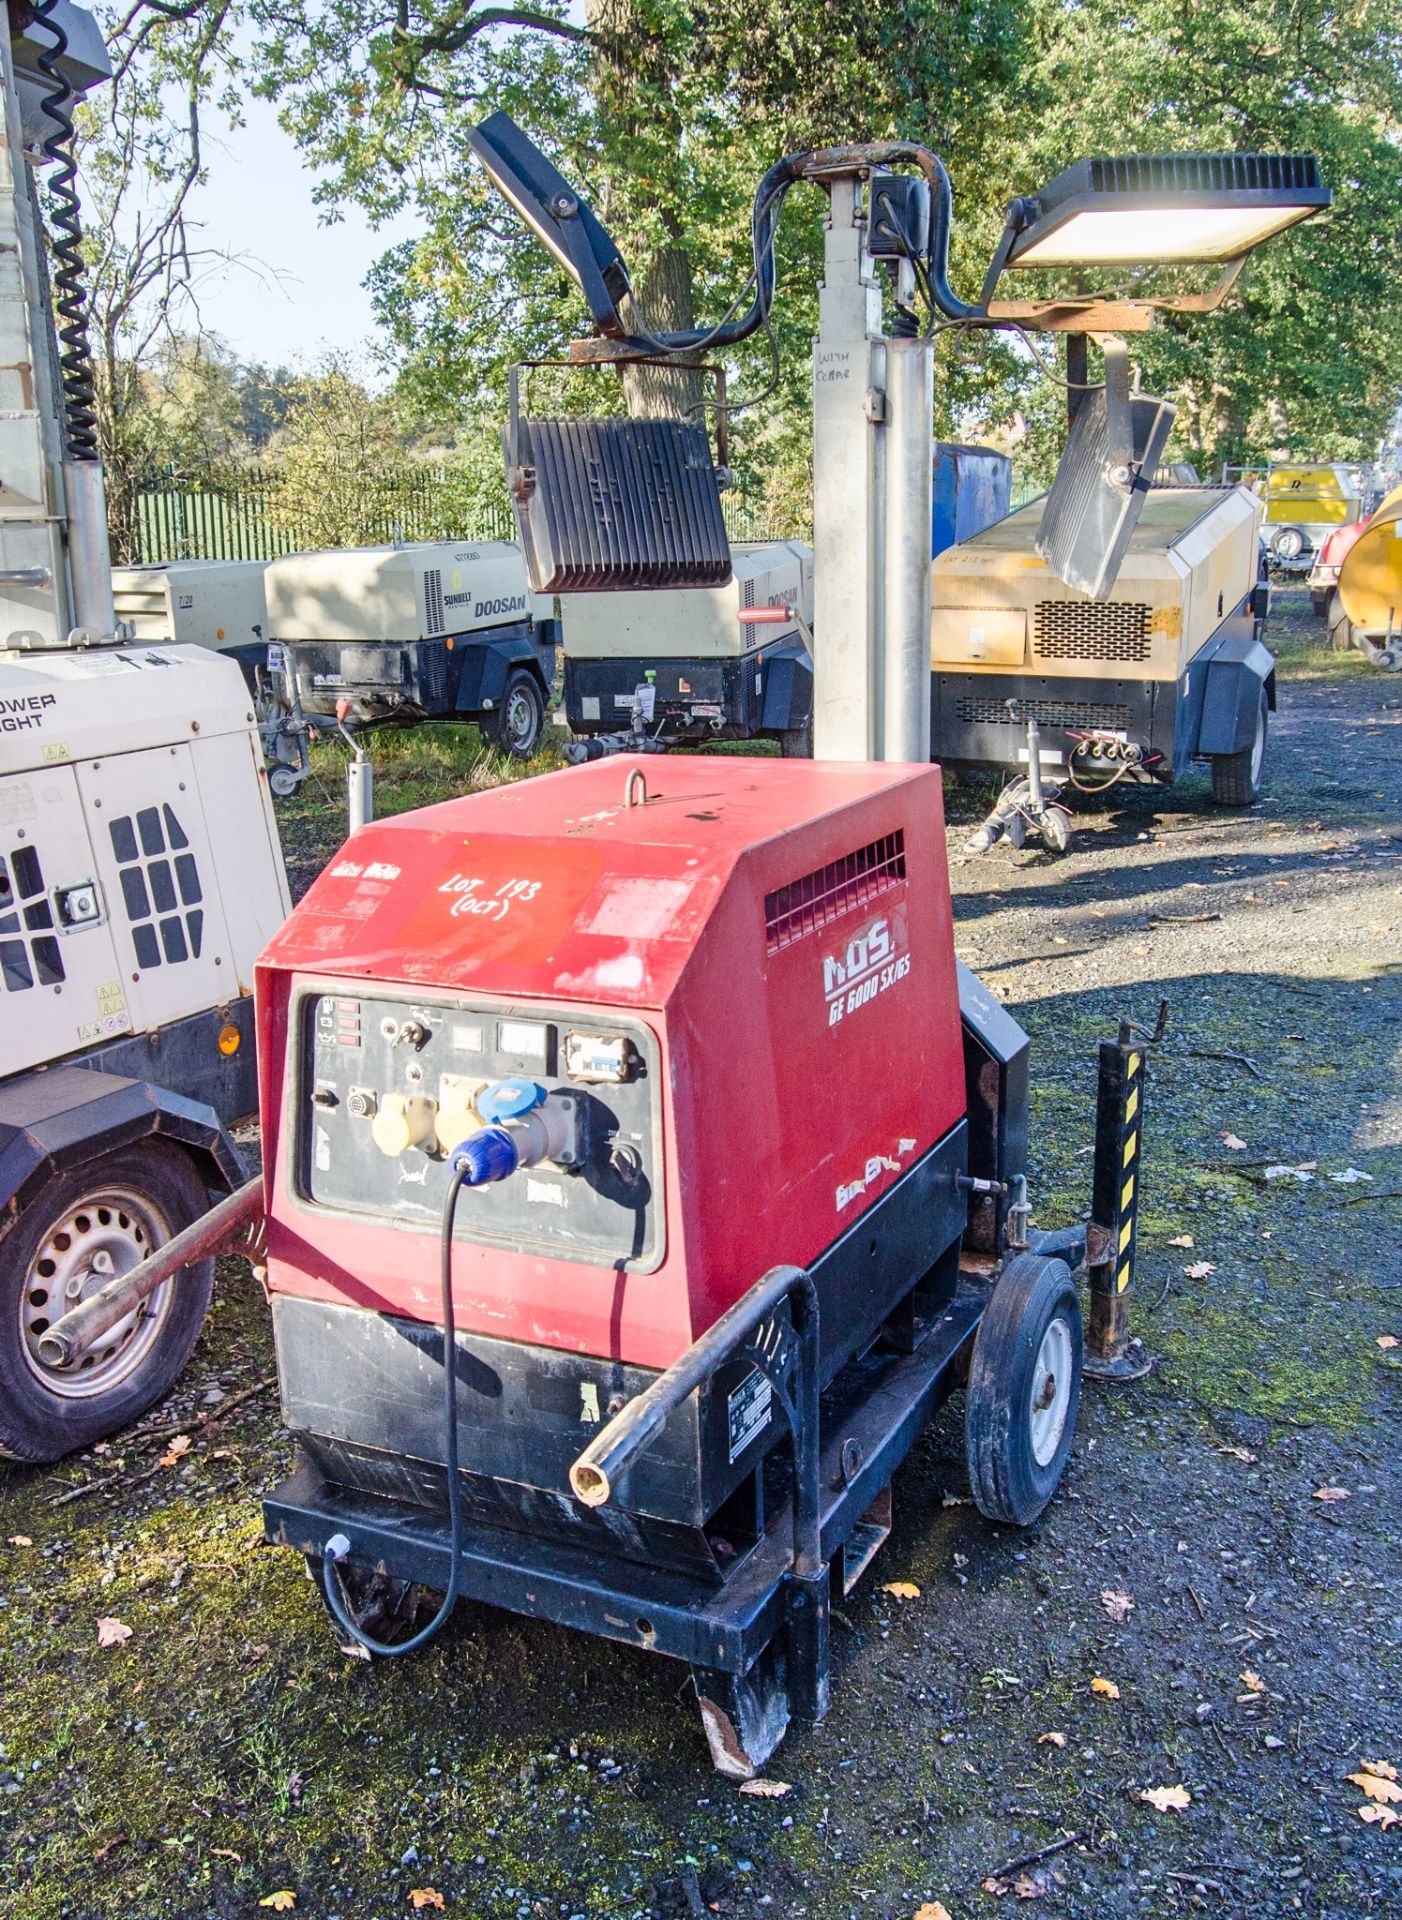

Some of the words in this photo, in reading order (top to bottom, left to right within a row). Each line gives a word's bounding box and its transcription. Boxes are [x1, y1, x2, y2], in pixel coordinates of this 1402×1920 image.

[818, 351, 849, 365] WITH
[443, 591, 472, 606] SUNBELT
[474, 594, 526, 618] DOOSAN
[0, 693, 57, 715] OWER
[0, 714, 43, 732] GHT
[437, 873, 485, 893] LOT
[495, 878, 543, 901] 193
[450, 893, 510, 921] (OCT)
[823, 919, 895, 994] MOS
[828, 996, 845, 1027] GE
[846, 974, 879, 1014] 6000
